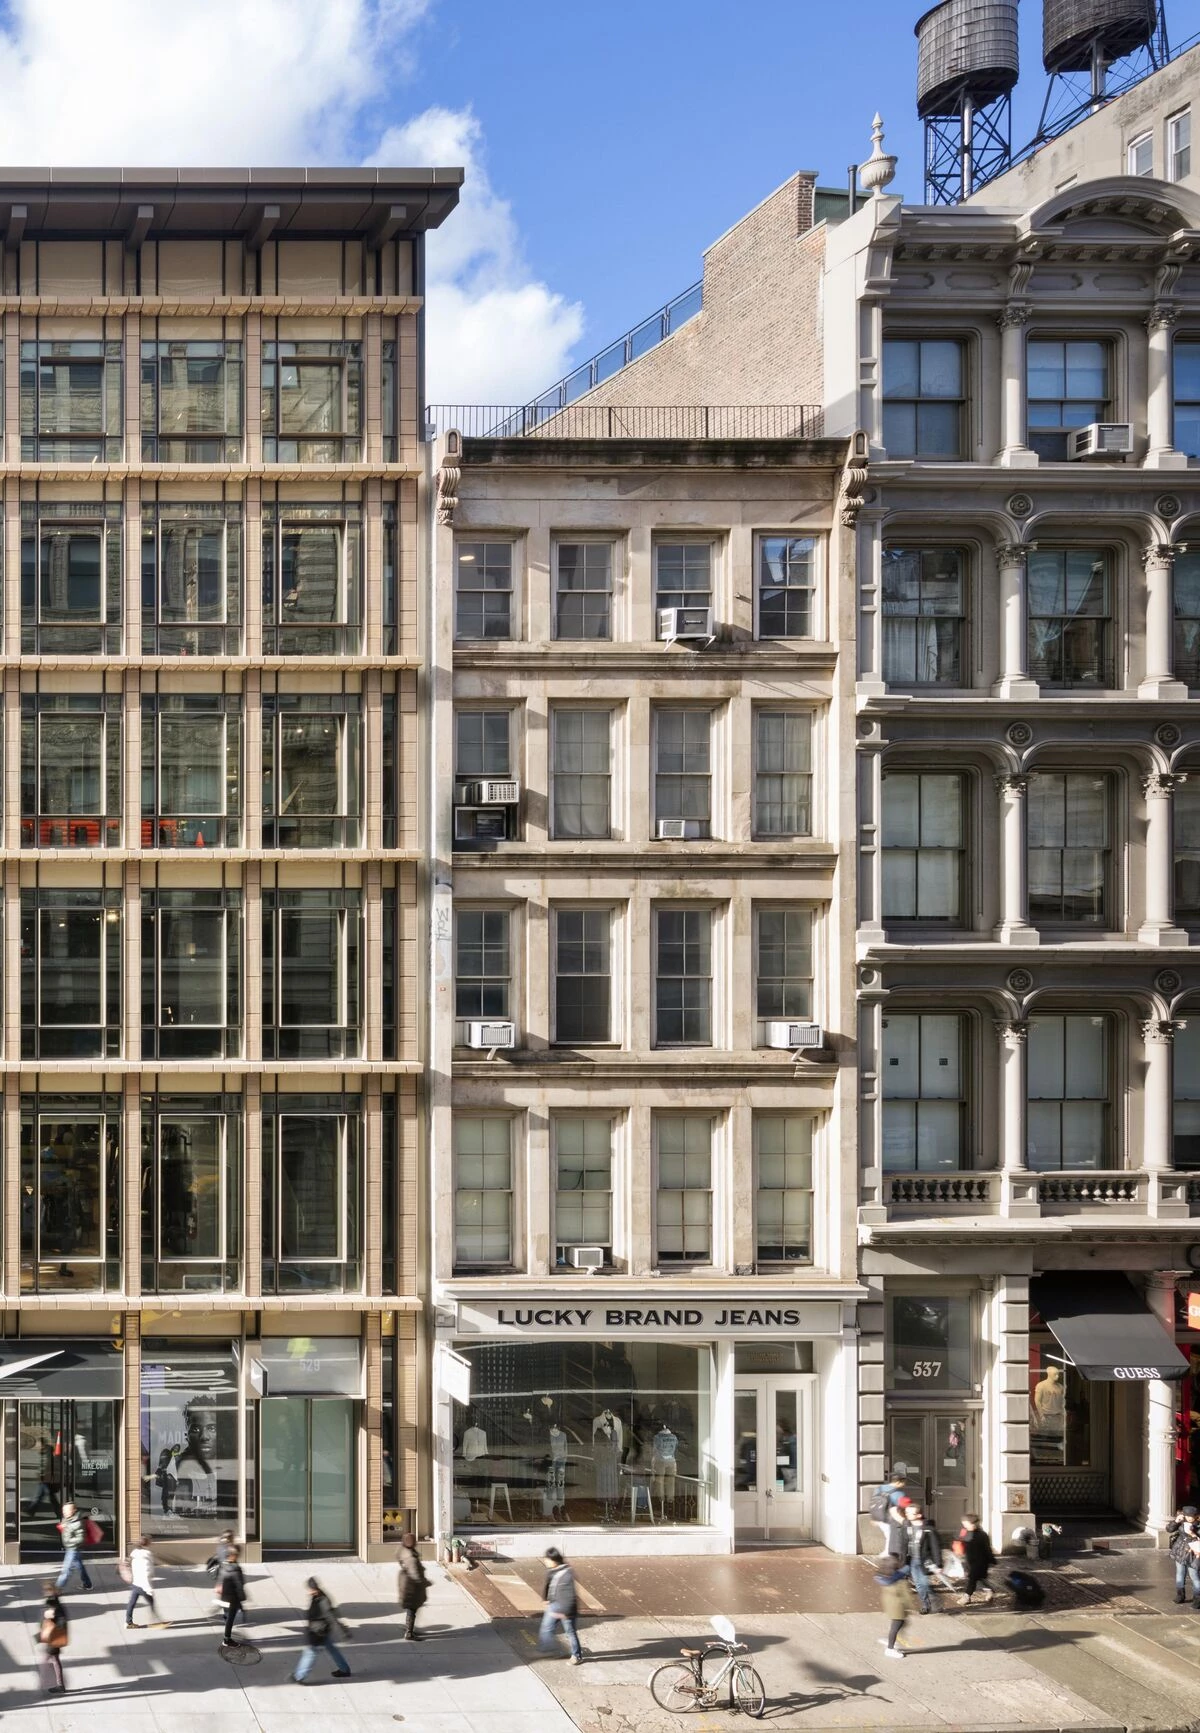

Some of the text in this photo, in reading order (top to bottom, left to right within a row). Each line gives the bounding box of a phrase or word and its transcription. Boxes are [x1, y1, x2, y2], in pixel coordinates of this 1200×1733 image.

[497, 1309, 801, 1326] LUCKY BRAND JEANS
[912, 1361, 942, 1377] 537
[1113, 1367, 1161, 1379] GUESS
